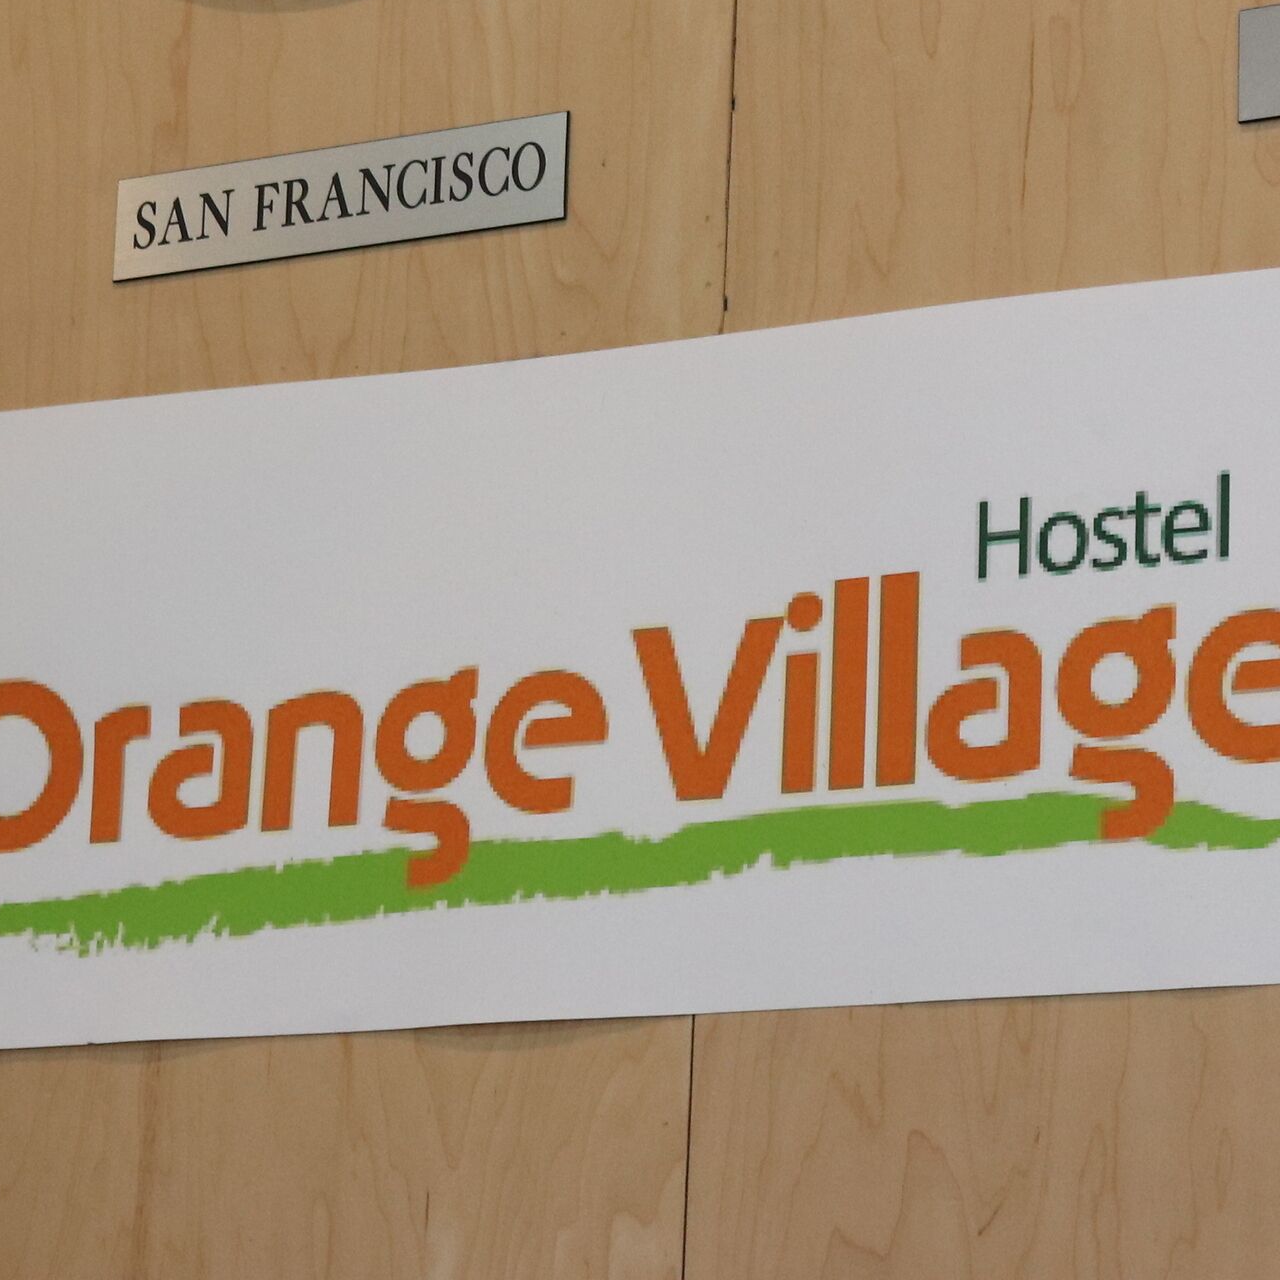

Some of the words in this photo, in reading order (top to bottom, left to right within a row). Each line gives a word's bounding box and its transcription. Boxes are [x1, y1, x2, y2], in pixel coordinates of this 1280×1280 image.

[133, 188, 235, 250] SAN
[252, 141, 547, 232] FRANCISCO
[977, 473, 1231, 580] Hostel
